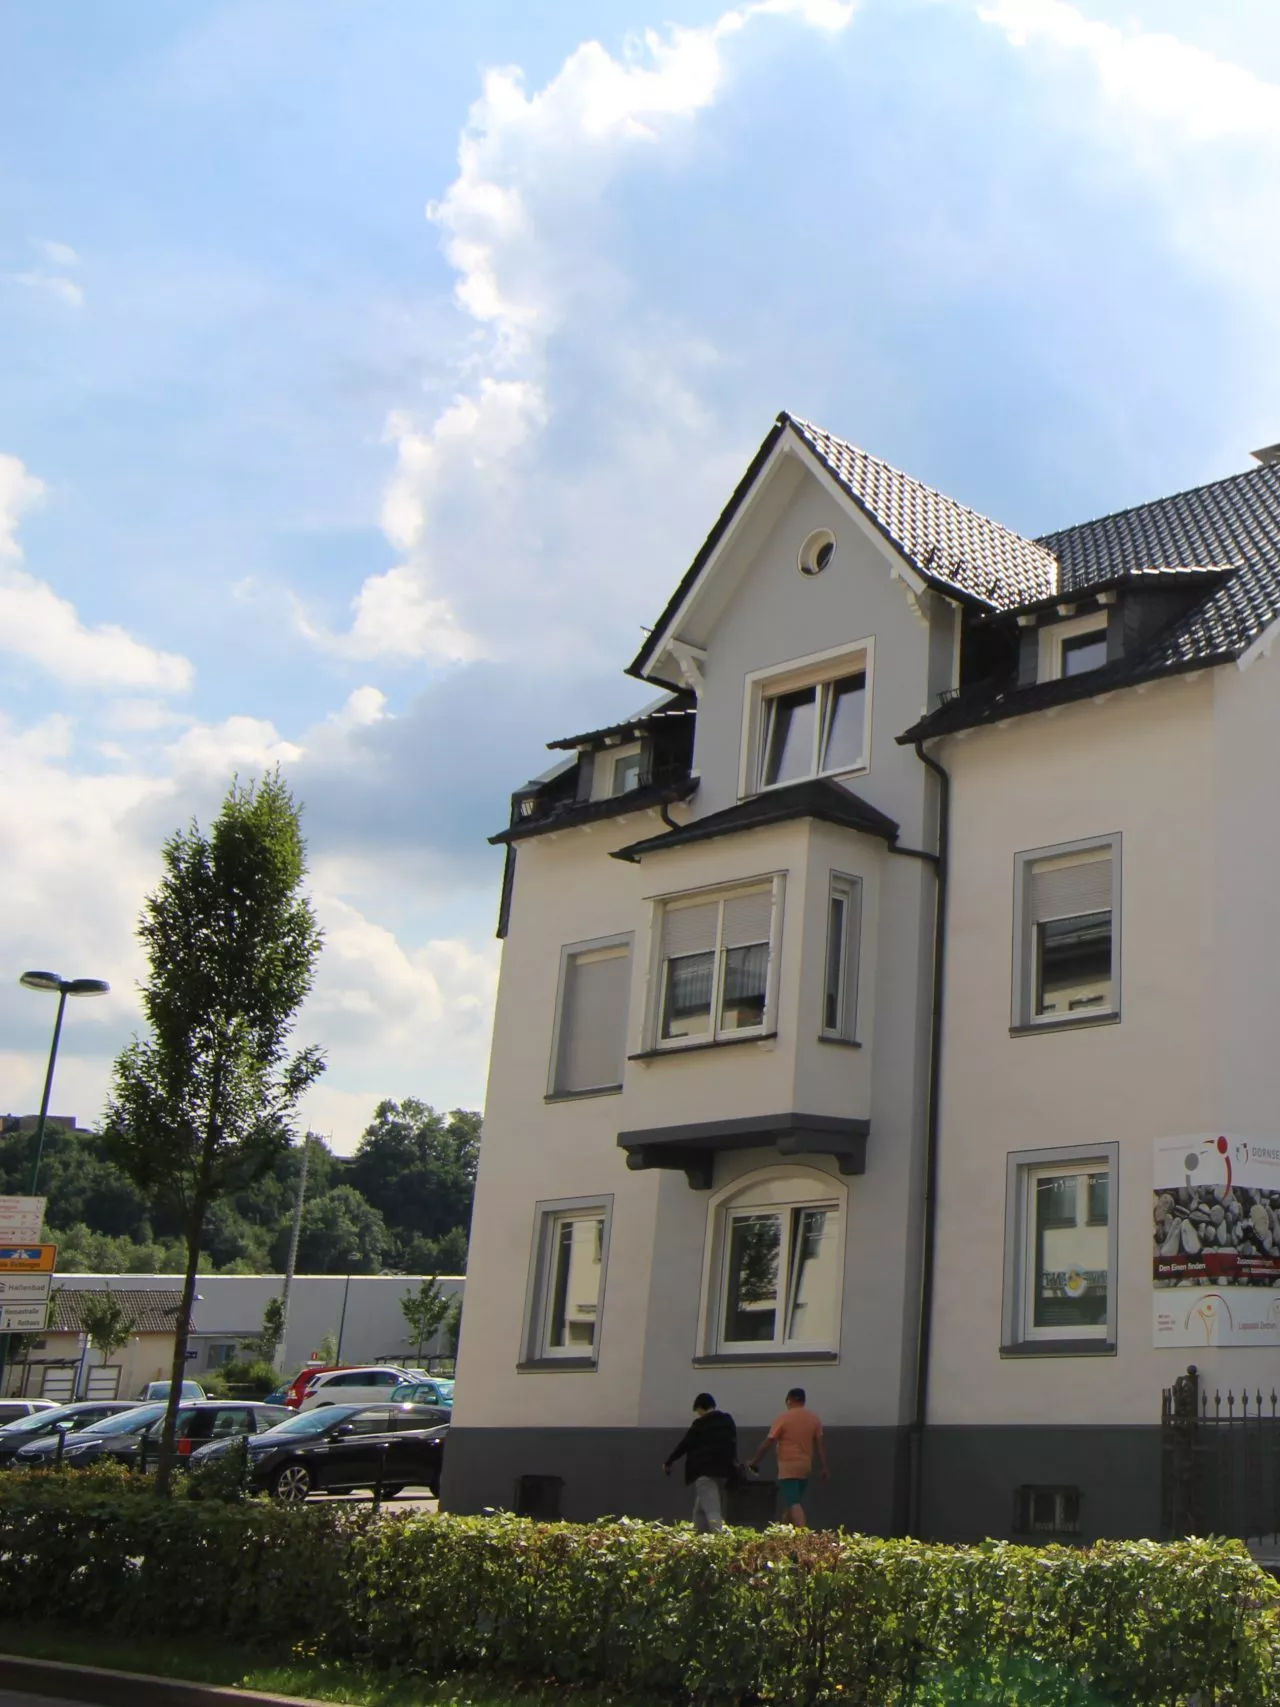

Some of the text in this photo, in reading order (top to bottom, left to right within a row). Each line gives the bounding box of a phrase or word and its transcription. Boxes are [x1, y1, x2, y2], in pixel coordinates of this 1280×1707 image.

[1158, 1262, 1206, 1272] Den Einen finden
[8, 1283, 46, 1291] Hallenbad
